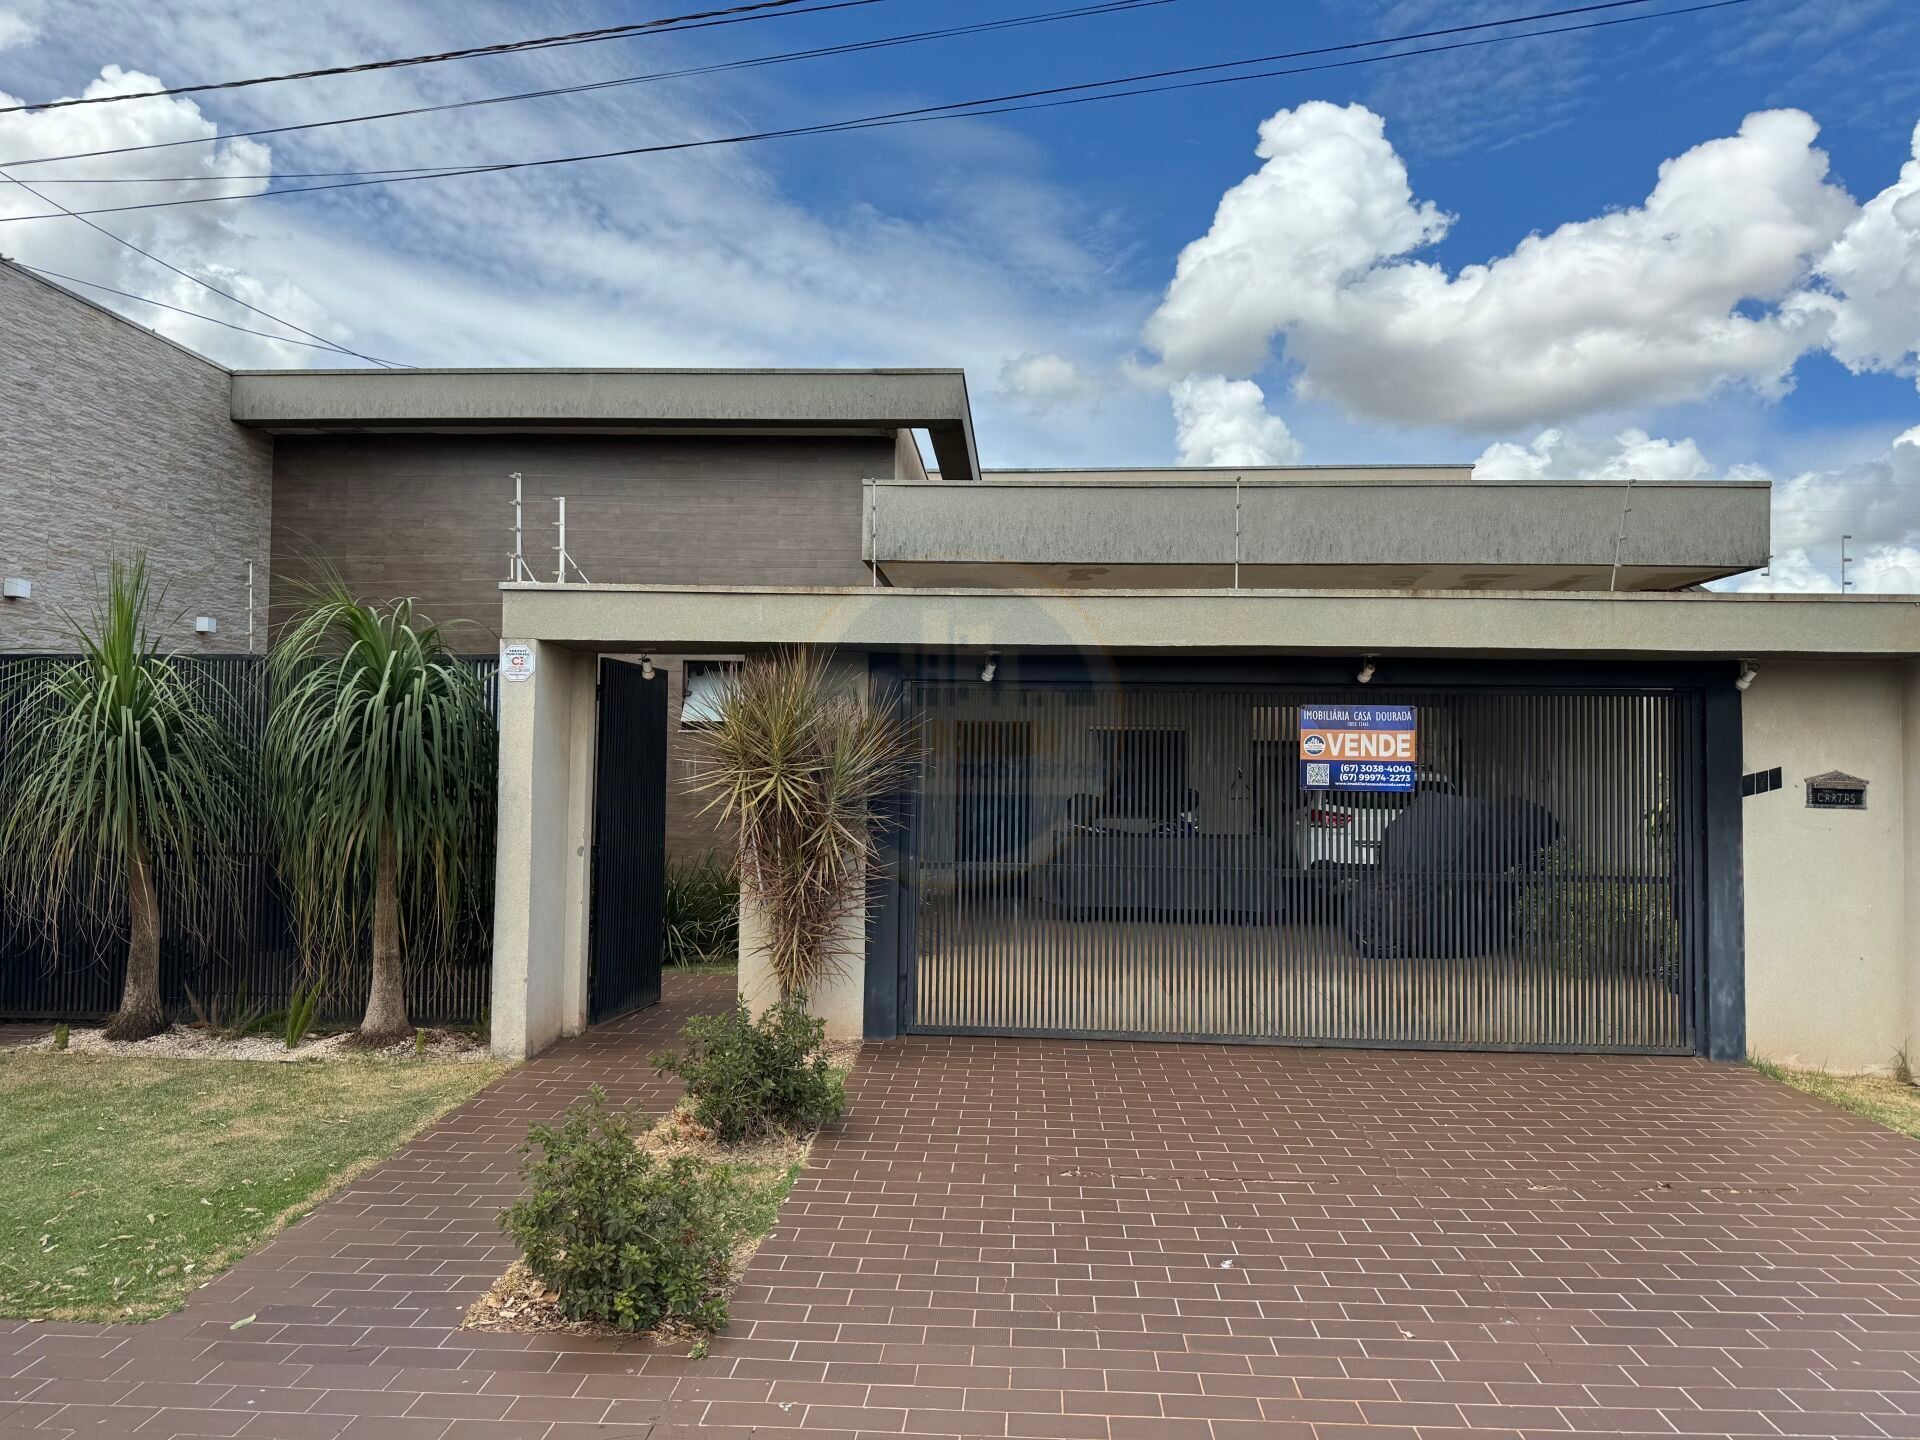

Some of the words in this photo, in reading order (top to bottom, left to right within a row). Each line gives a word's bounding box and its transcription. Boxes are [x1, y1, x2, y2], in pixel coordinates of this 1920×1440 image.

[1303, 709, 1350, 721] IMOBILIÁRIA
[1353, 711, 1372, 721] CASA
[1376, 711, 1412, 722] DOURADA
[1326, 733, 1411, 757] VENDE
[1341, 764, 1358, 773] (67)
[1360, 765, 1412, 773] 3038-4040
[1340, 773, 1357, 782] (67)
[1359, 774, 1411, 782] 99974-2273
[1817, 792, 1856, 804] CARTAS
